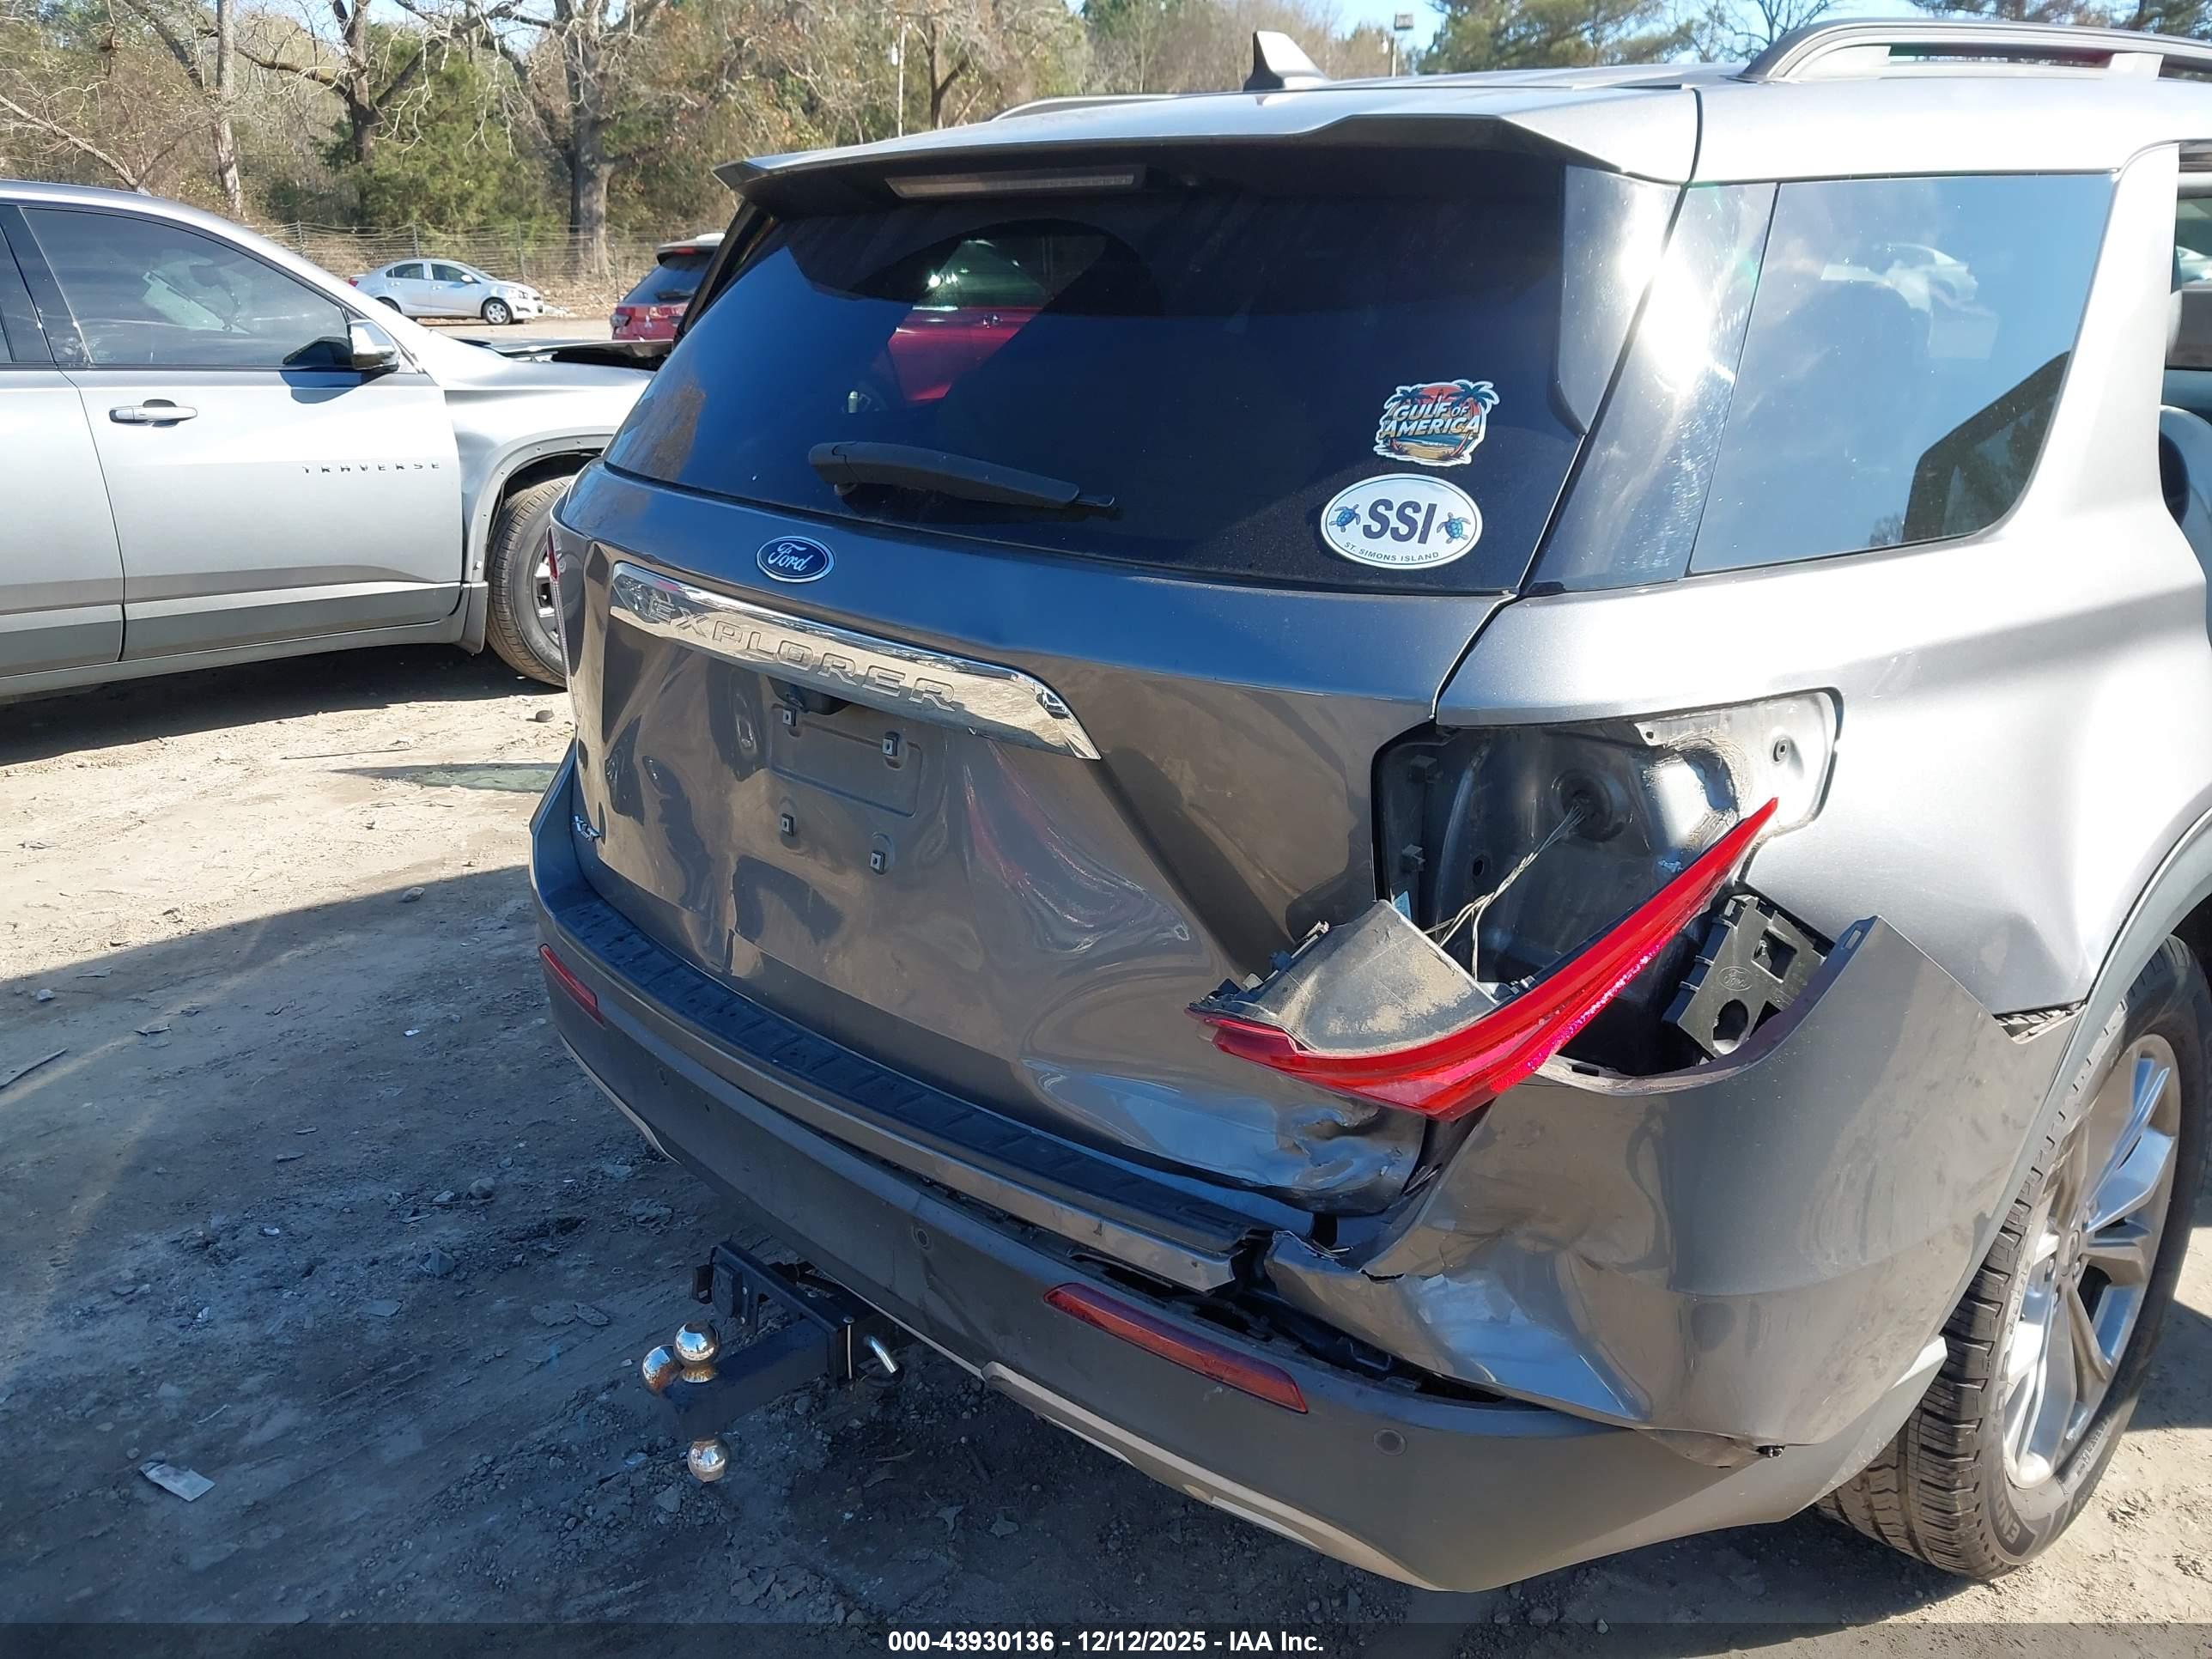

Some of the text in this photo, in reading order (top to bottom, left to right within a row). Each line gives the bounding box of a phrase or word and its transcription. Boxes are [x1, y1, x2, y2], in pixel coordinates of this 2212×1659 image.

[1392, 401, 1471, 421] GULF OF
[1378, 415, 1480, 439] AMERICA
[1362, 498, 1437, 544] SSI
[768, 542, 815, 571] Ford
[1344, 542, 1439, 562] ST. SIMONS ISLAND
[650, 596, 956, 712] EXPLORER
